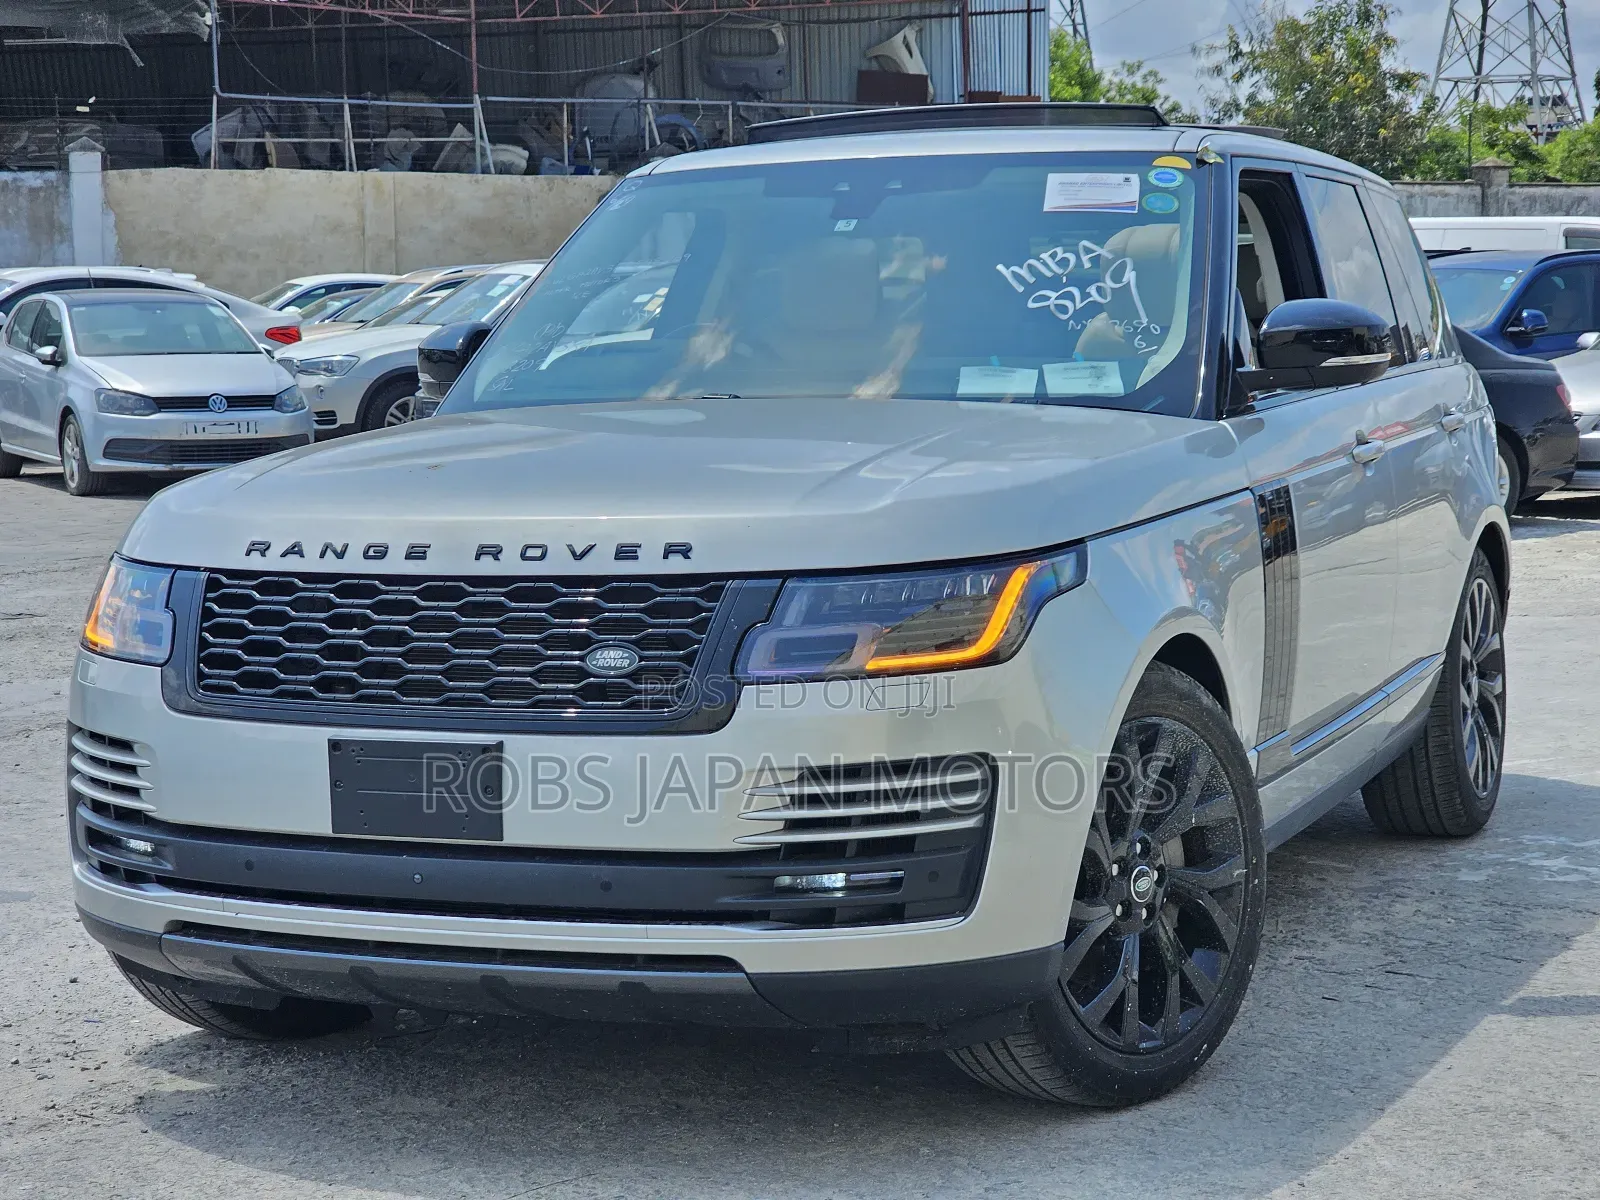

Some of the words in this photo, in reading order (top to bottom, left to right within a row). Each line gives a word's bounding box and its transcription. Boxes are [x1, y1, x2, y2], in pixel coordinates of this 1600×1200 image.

[1026, 257, 1149, 323] 8209
[244, 540, 432, 561] RANGE
[474, 541, 694, 562] ROVER
